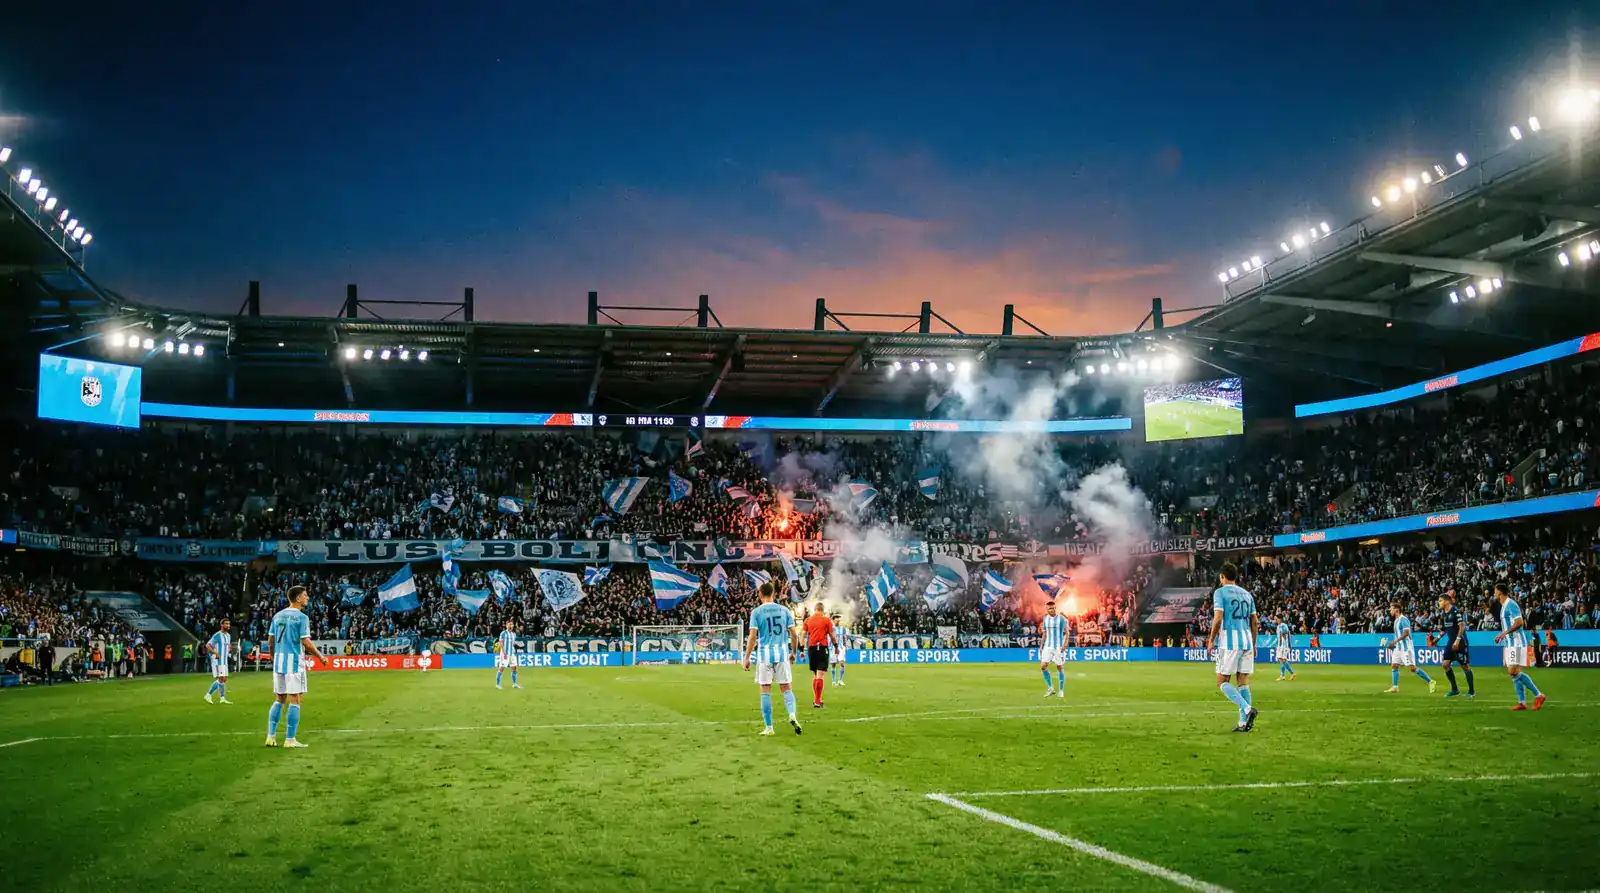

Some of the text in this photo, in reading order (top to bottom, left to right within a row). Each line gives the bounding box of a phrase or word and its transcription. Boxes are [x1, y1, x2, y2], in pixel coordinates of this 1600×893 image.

[325, 542, 438, 561] LUS
[1231, 599, 1249, 619] 20
[277, 622, 287, 643] 7
[766, 615, 783, 636] 15
[333, 657, 388, 668] STRAUSS
